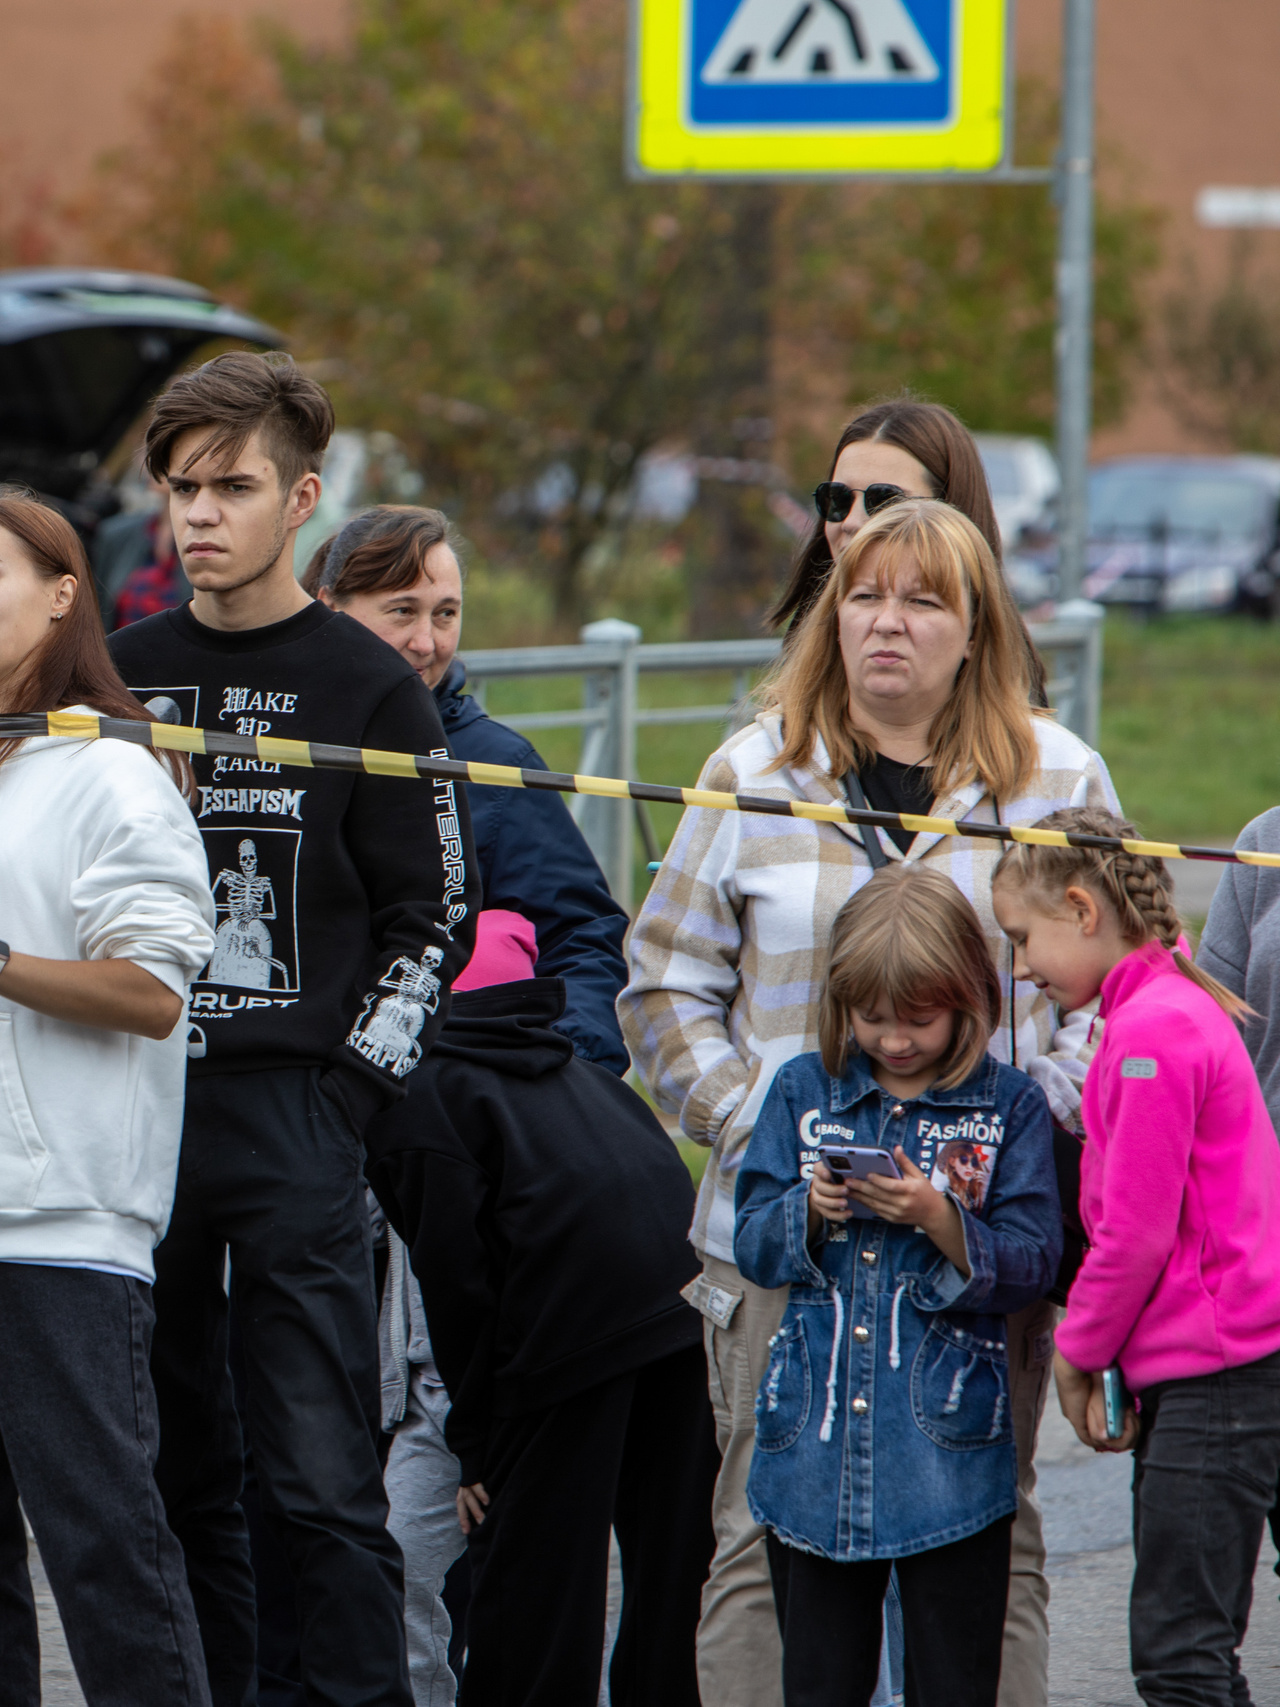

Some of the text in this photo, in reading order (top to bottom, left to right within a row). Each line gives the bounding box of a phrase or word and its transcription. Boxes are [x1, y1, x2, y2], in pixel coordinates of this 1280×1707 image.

[219, 686, 298, 720] WAKE
[197, 786, 307, 821] ESCAPISM
[188, 992, 300, 1010] RUPT
[917, 1119, 1005, 1144] FASHION
